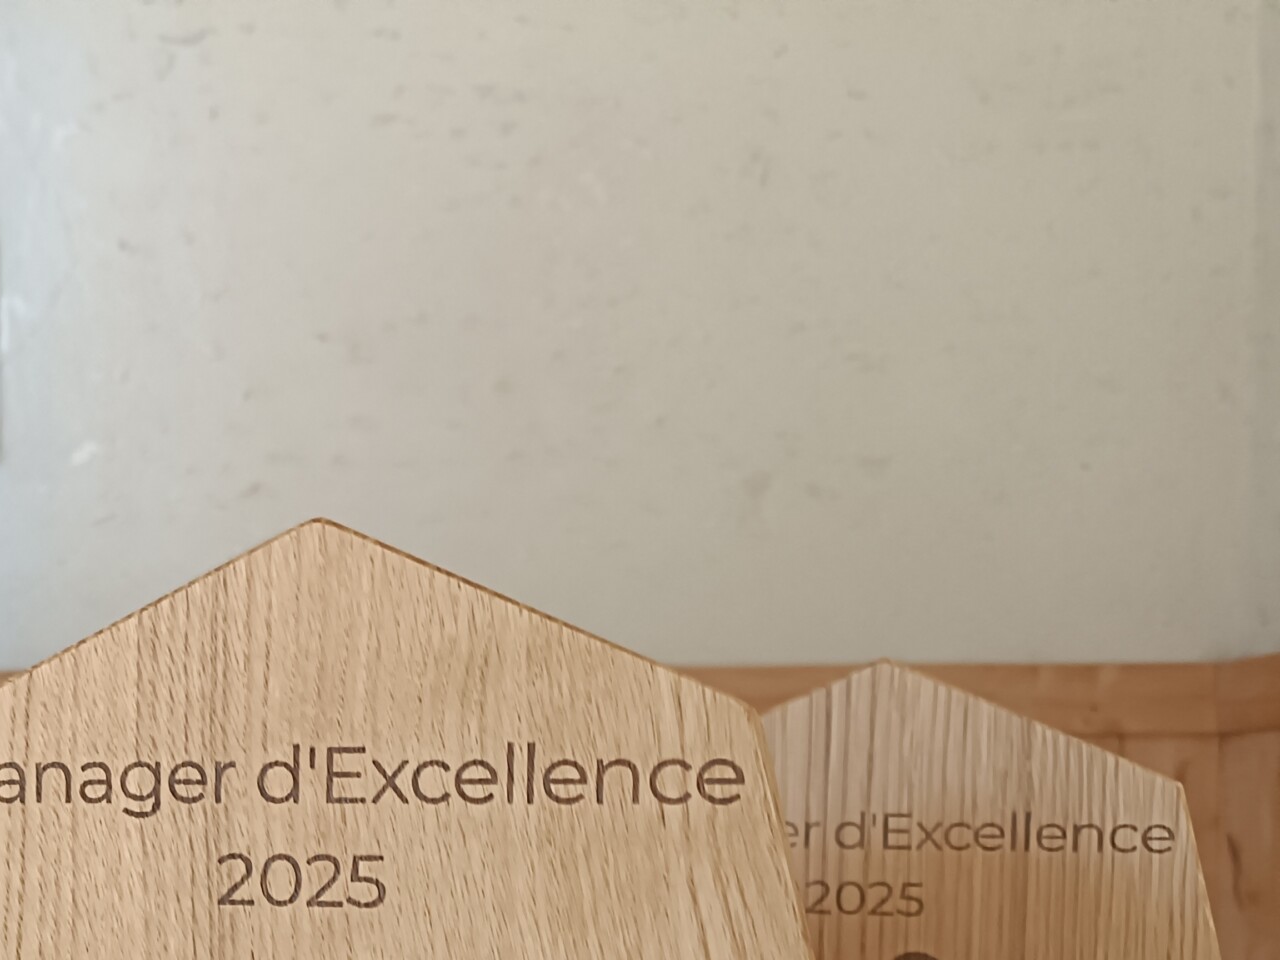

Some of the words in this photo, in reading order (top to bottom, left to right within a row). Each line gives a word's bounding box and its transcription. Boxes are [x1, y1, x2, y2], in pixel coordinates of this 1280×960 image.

[257, 741, 746, 806] d'Excellence
[834, 810, 1176, 854] d'Excellence
[216, 852, 387, 909] 2025
[804, 880, 925, 917] 2025
